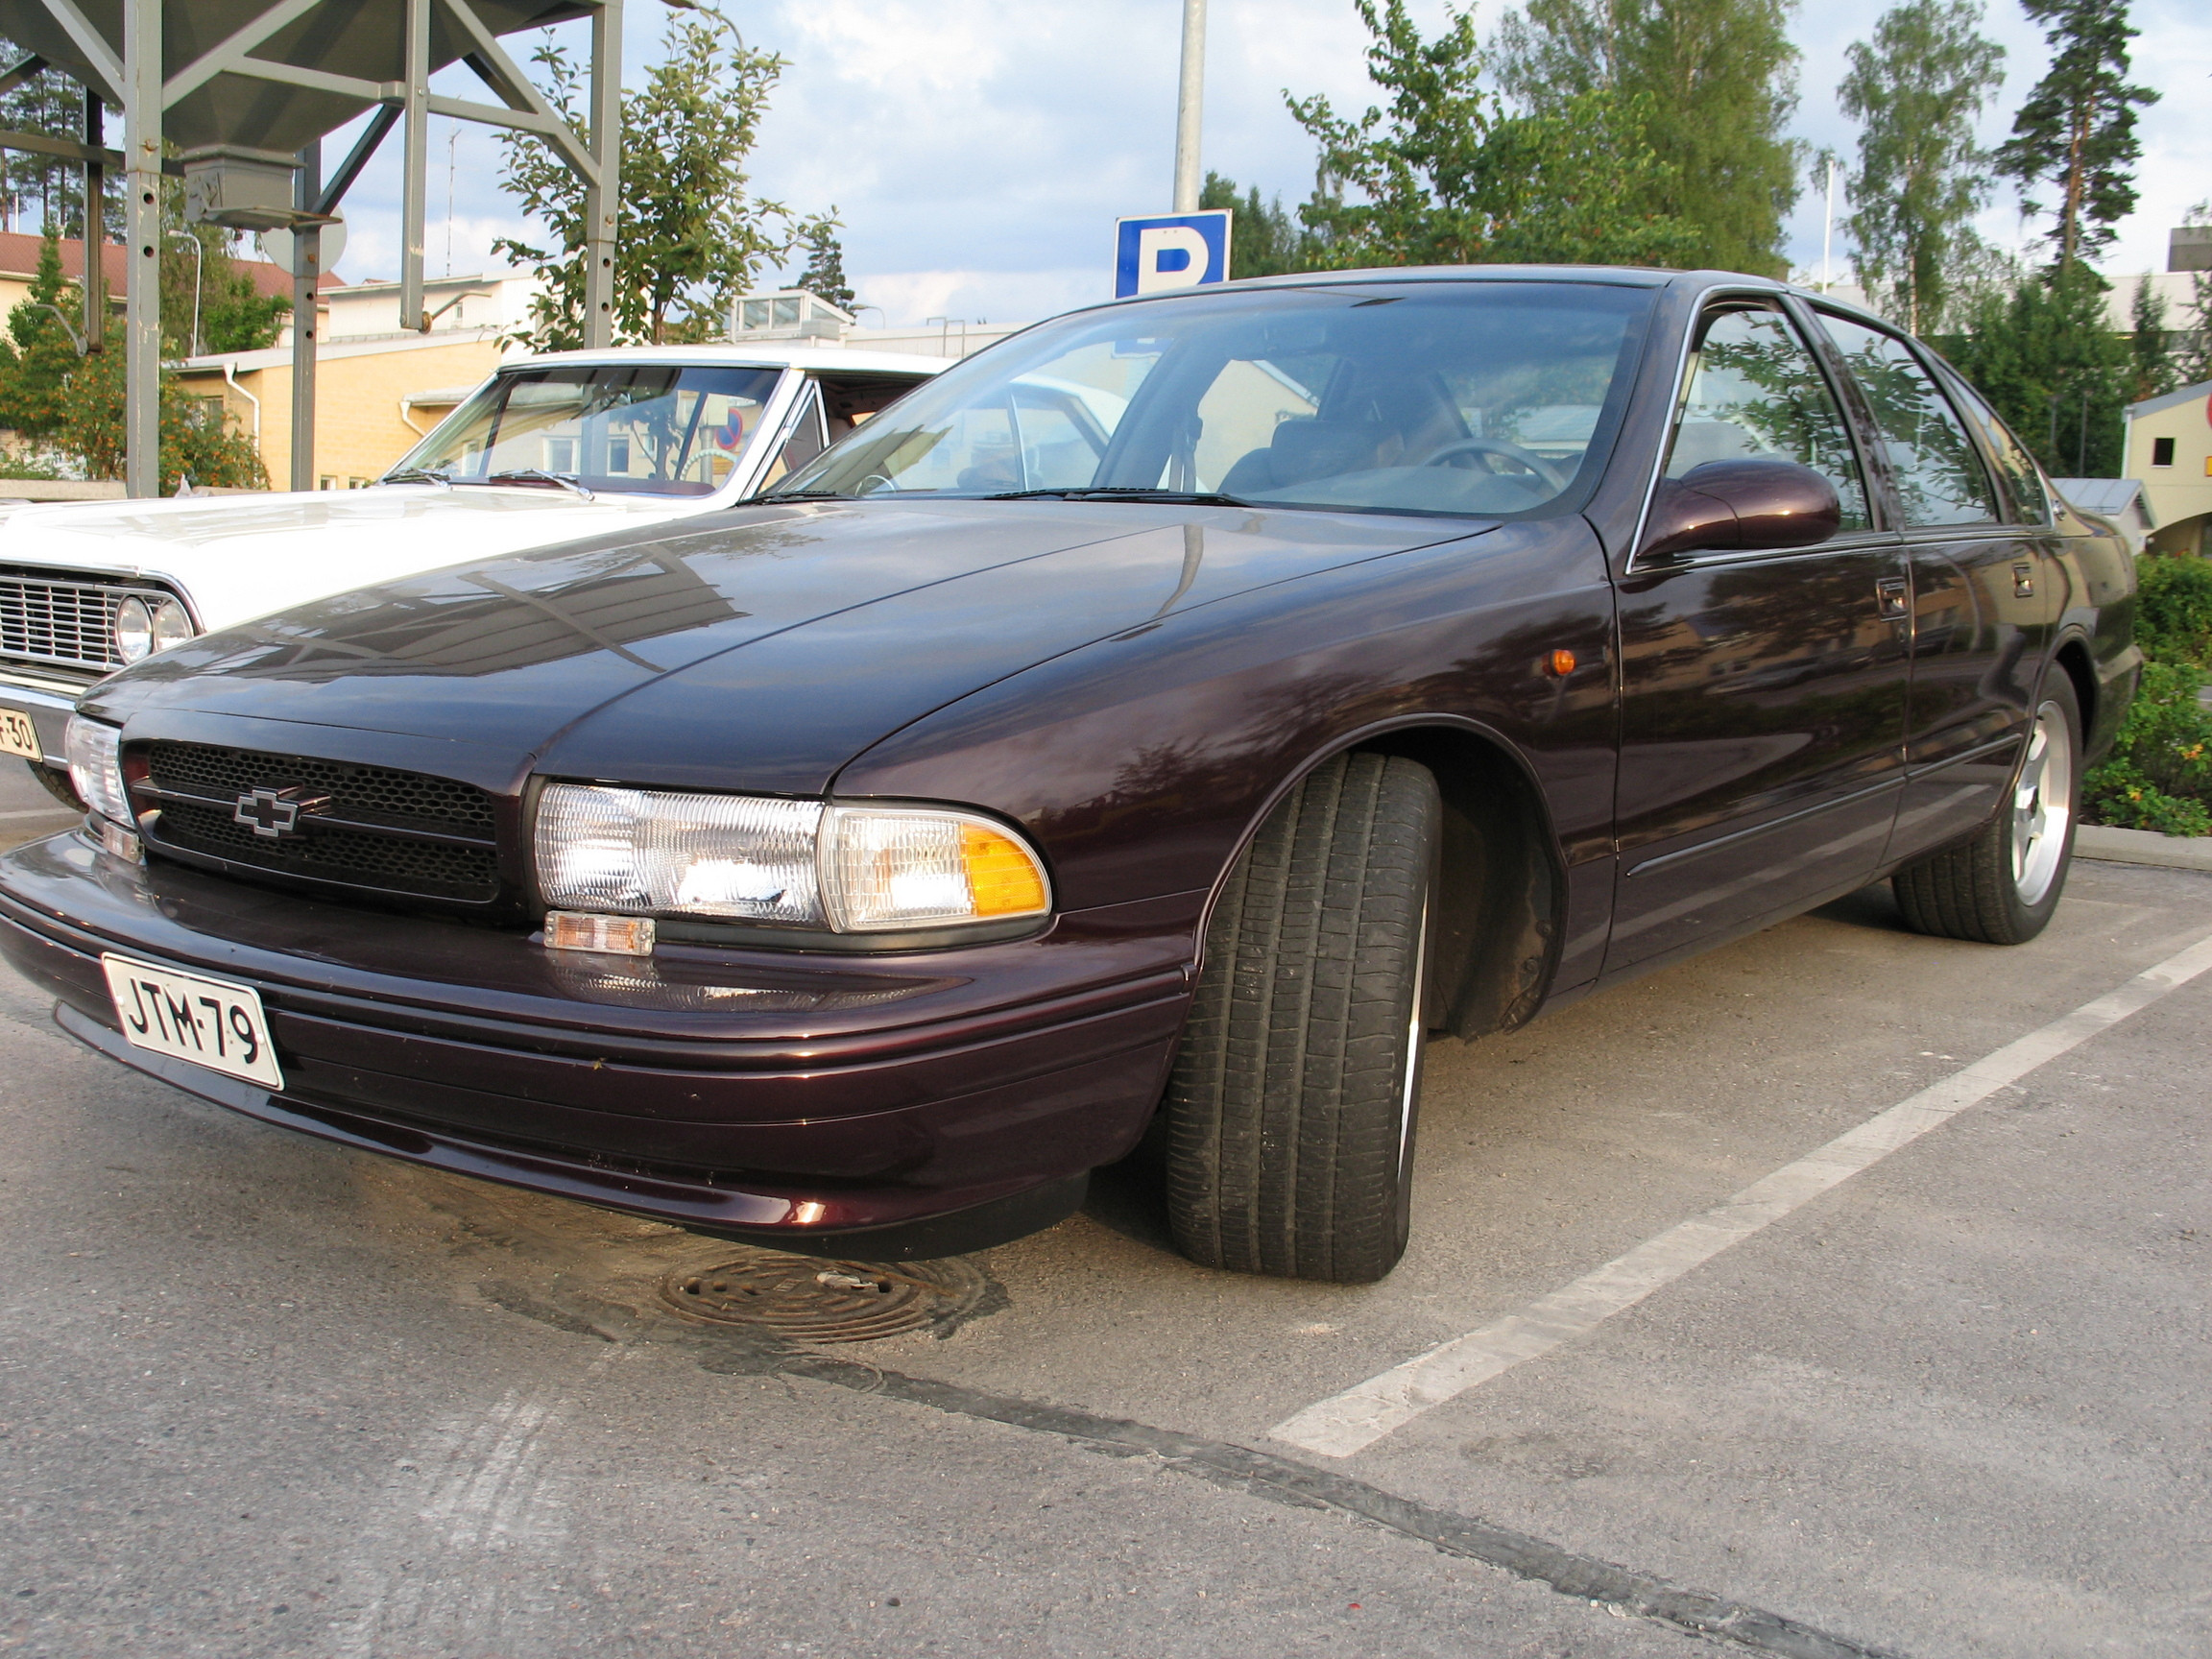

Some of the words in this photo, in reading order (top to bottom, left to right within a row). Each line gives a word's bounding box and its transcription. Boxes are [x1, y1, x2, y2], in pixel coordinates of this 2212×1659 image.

[1138, 226, 1210, 295] P
[0, 714, 33, 750] -30
[128, 977, 259, 1065] JTM-79
